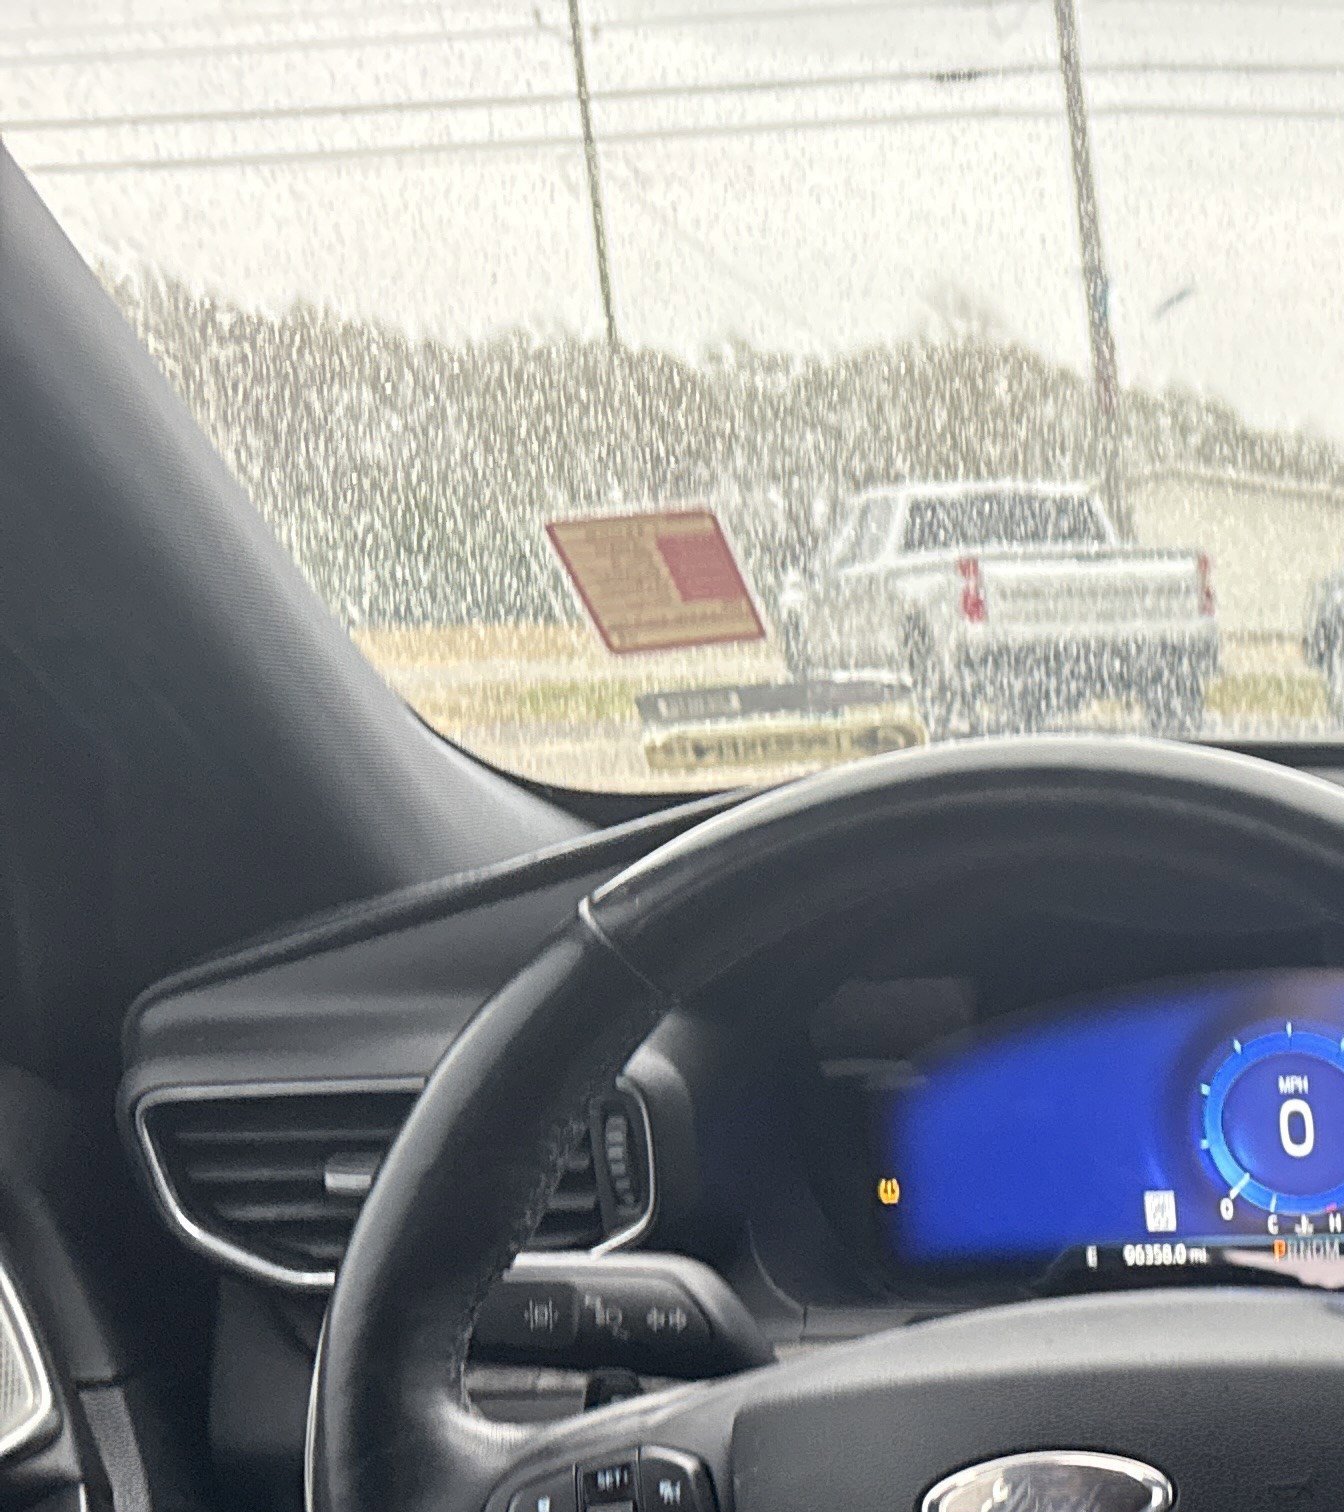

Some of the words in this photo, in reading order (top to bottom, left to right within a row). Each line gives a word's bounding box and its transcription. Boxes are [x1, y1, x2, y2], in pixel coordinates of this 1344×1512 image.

[1278, 1075, 1309, 1095] MPH
[1279, 1098, 1315, 1158] 0
[1219, 1197, 1234, 1221] 0
